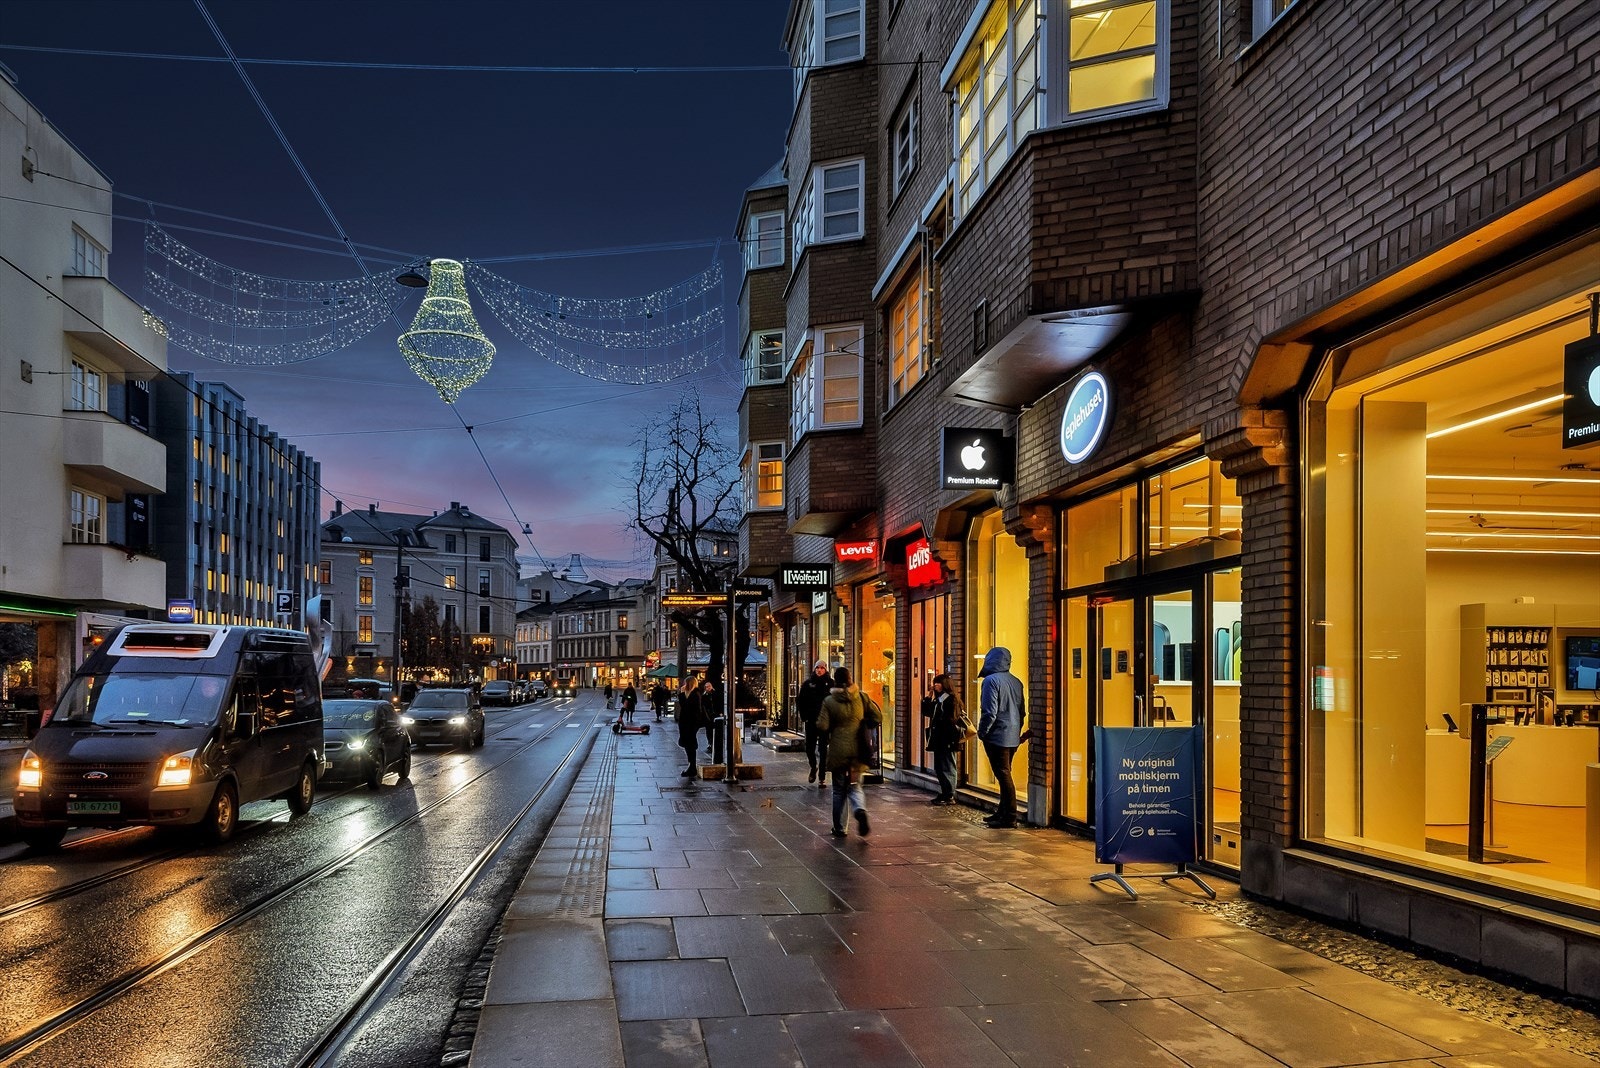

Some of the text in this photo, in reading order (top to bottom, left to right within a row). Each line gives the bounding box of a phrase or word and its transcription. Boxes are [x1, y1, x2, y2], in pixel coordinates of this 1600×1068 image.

[1065, 388, 1103, 441] eplehuset
[1568, 422, 1600, 439] Premiu
[947, 476, 999, 486] Premium Reseller
[791, 573, 820, 582] Wolford
[279, 594, 290, 606] P
[1122, 758, 1175, 769] Ny original
[1119, 771, 1180, 782] mobilskjerm
[1127, 784, 1171, 795] på timen
[73, 802, 119, 811] DR 67210
